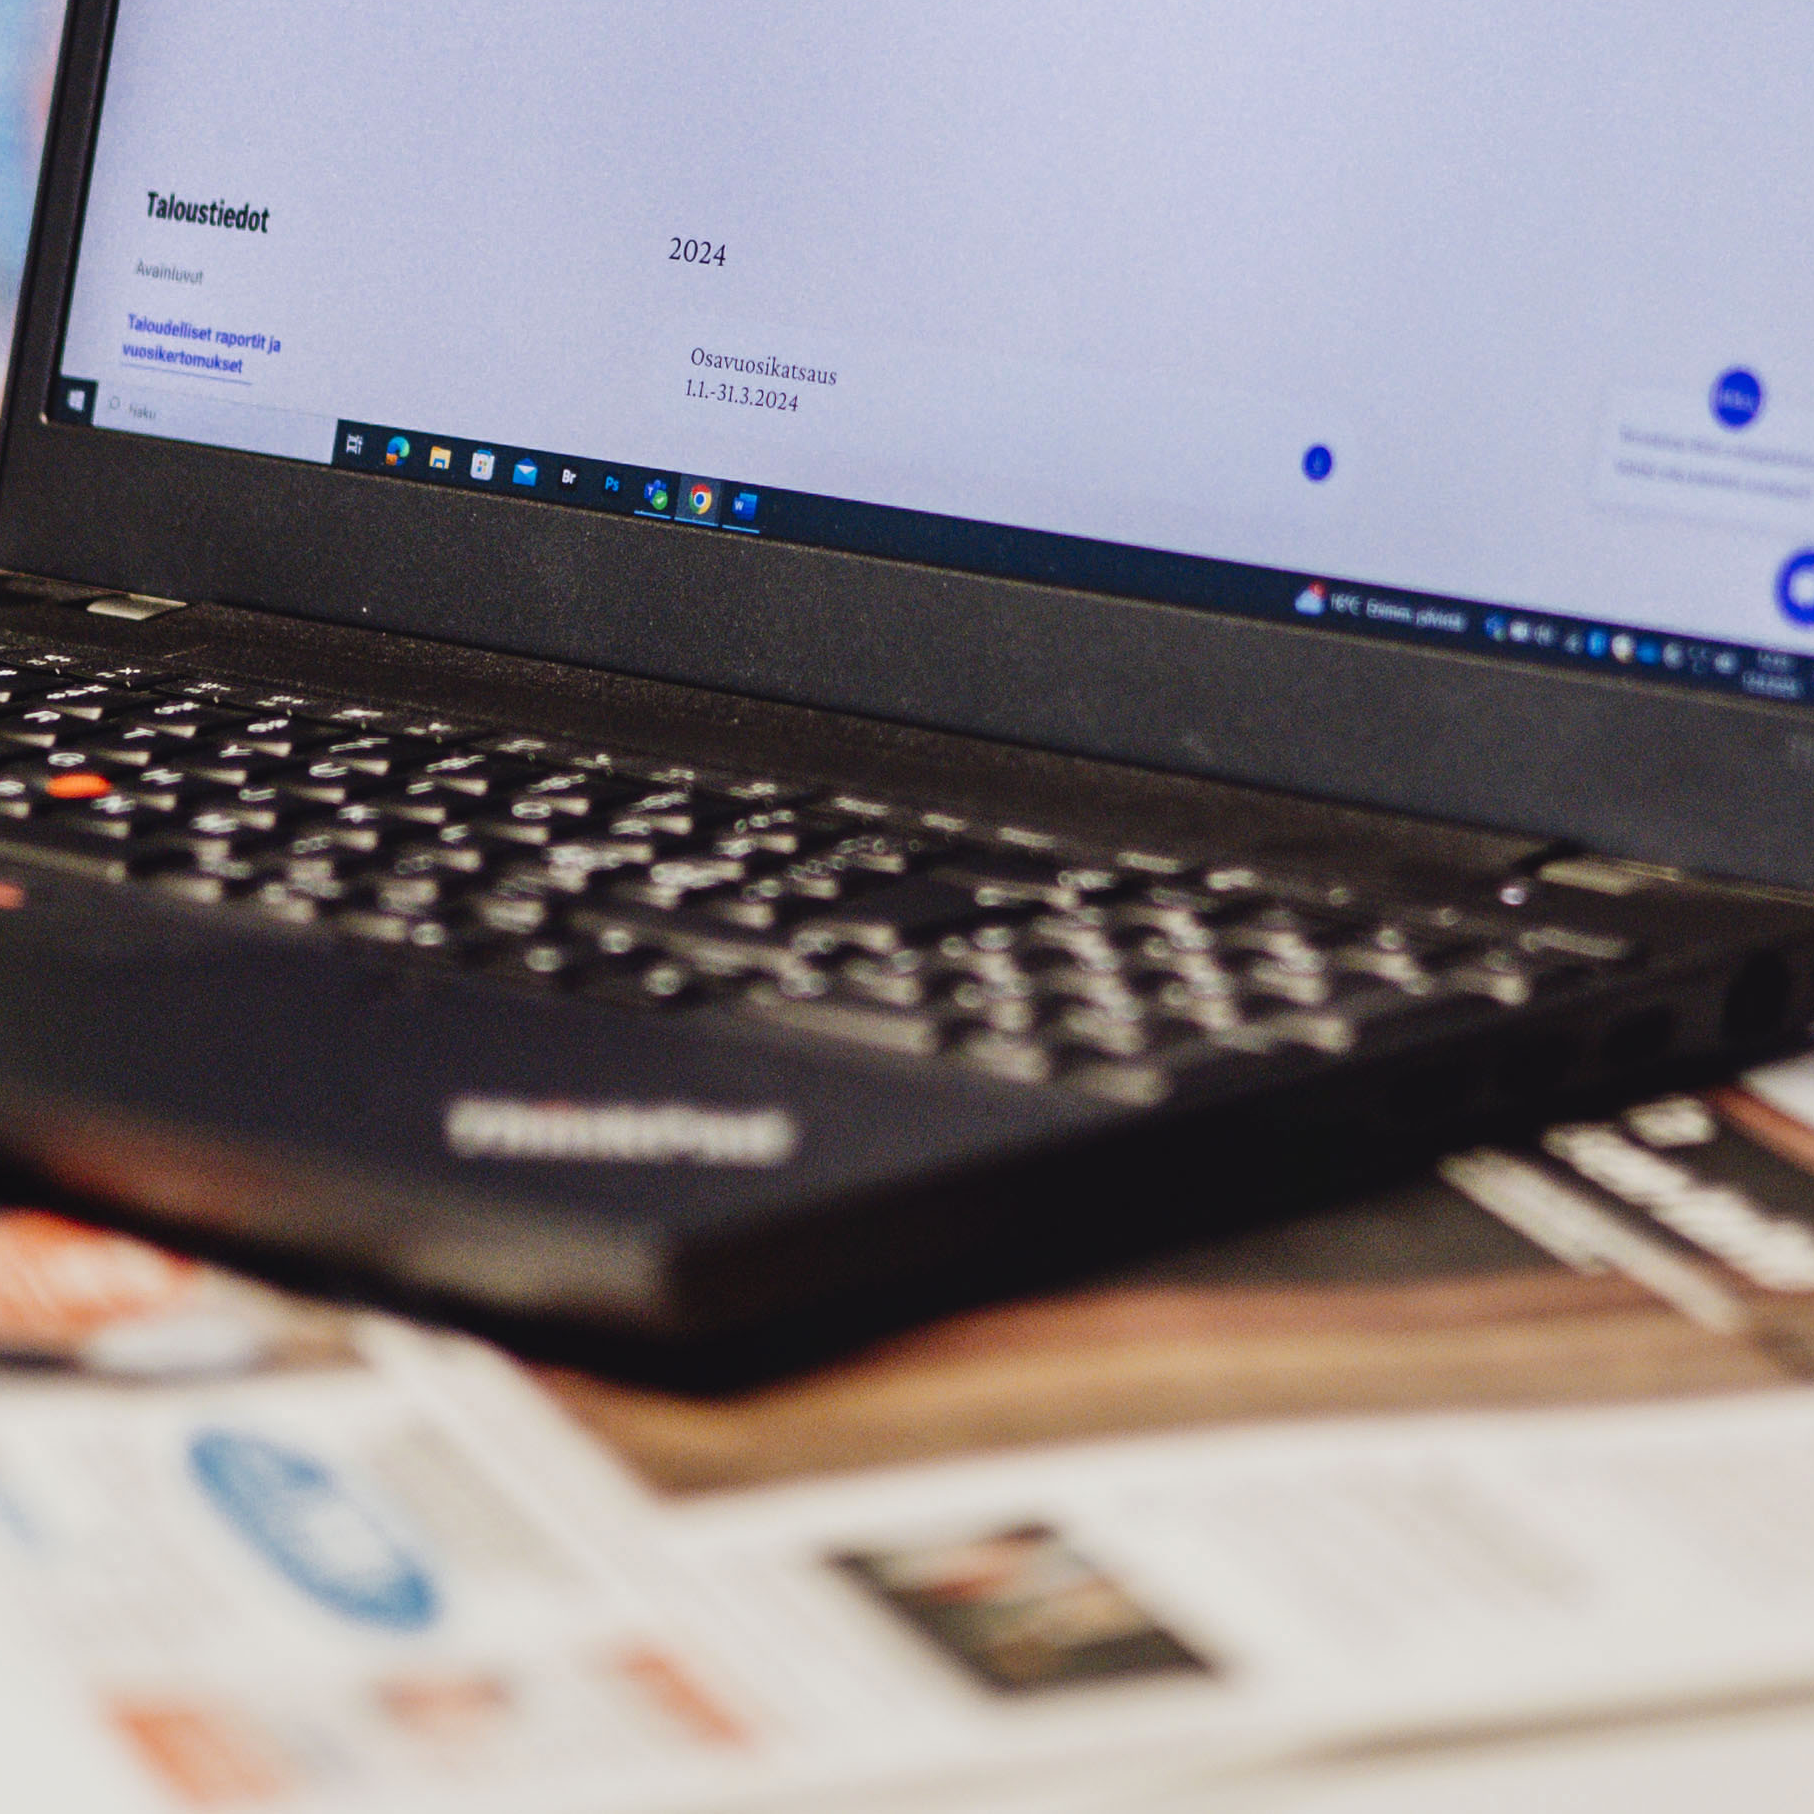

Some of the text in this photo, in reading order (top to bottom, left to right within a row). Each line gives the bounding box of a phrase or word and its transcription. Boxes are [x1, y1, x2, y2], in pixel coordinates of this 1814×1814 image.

[147, 190, 272, 235] Taloustiedot
[668, 237, 727, 267] 2024
[136, 258, 205, 286] Avainluvut
[128, 312, 282, 355] Taloudelliset raportit ja
[122, 343, 244, 374] vuosikertomukset
[690, 347, 839, 386] Osavuosikatsaus
[685, 378, 799, 413] 1.1.-31.3.2024
[561, 468, 577, 485] Br
[605, 475, 620, 492] Ps
